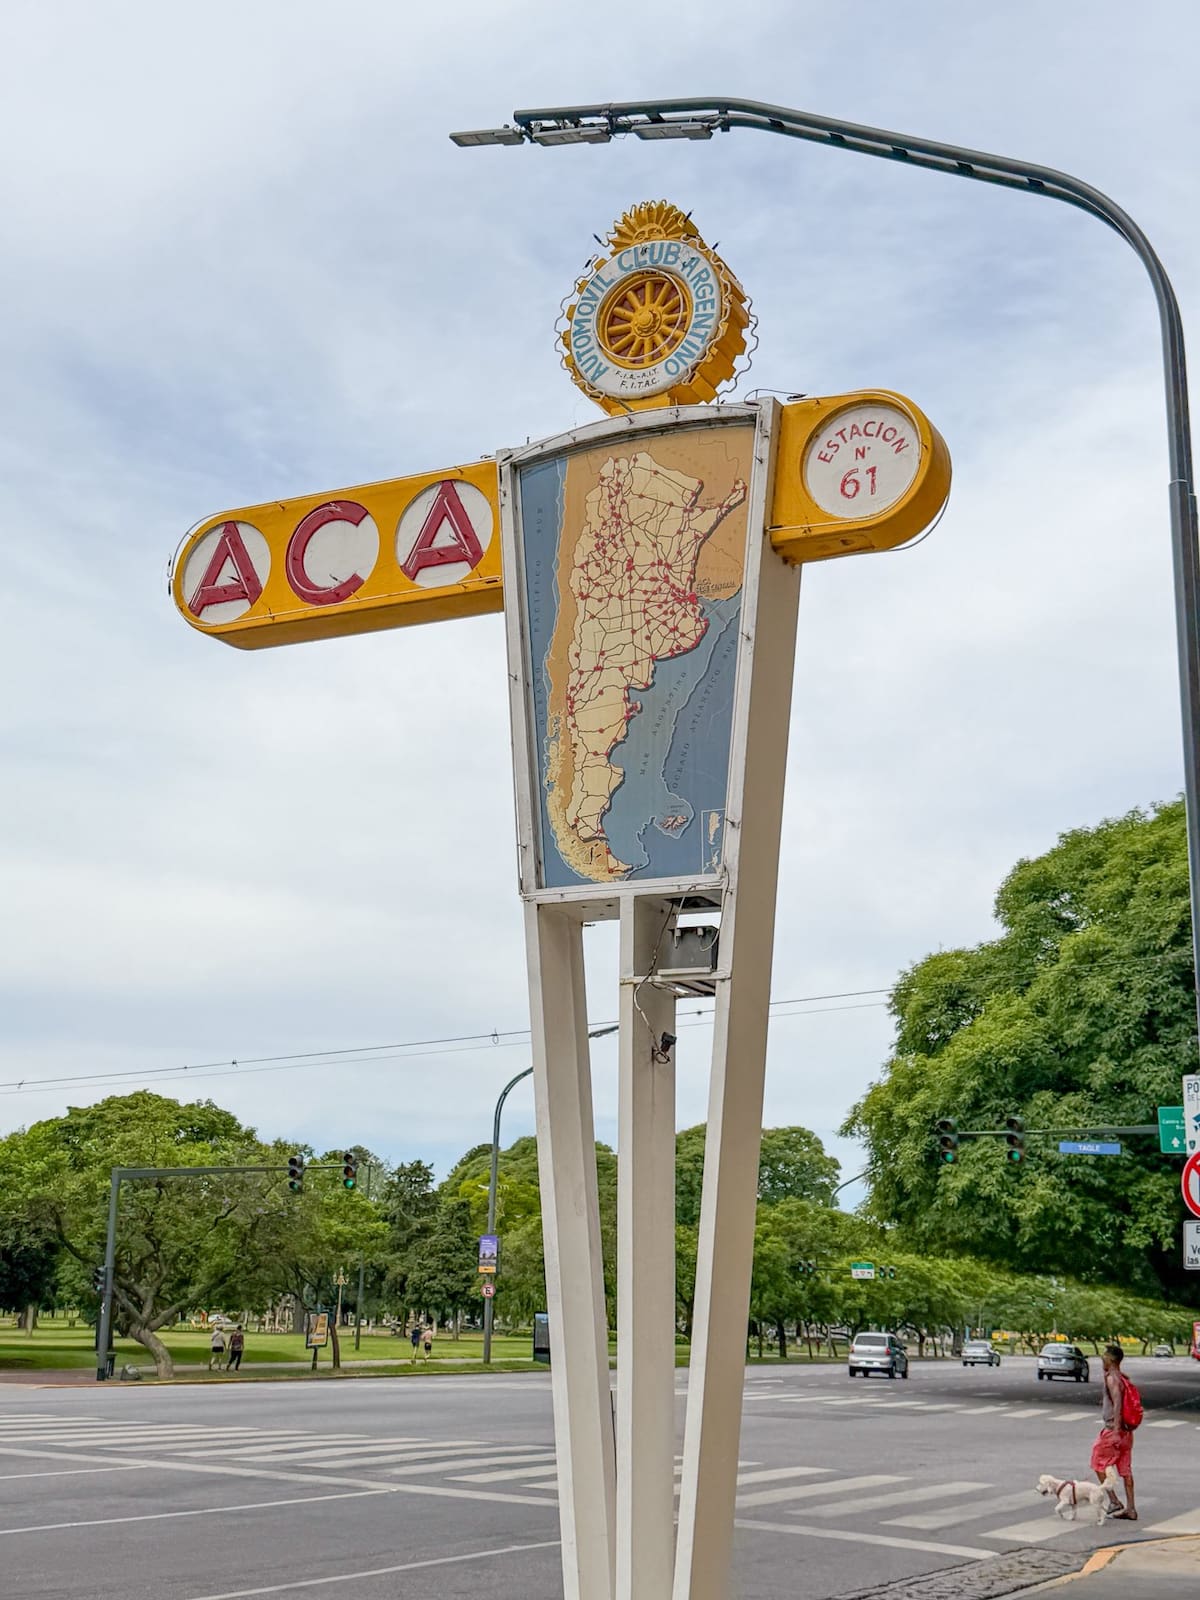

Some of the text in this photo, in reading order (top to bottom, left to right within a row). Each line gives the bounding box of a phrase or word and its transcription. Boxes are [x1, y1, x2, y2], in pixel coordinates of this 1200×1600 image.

[572, 242, 715, 384] AUTOMOVIL CLUB ARGENTINO
[817, 420, 910, 464] ESTACION
[840, 465, 878, 499] 61
